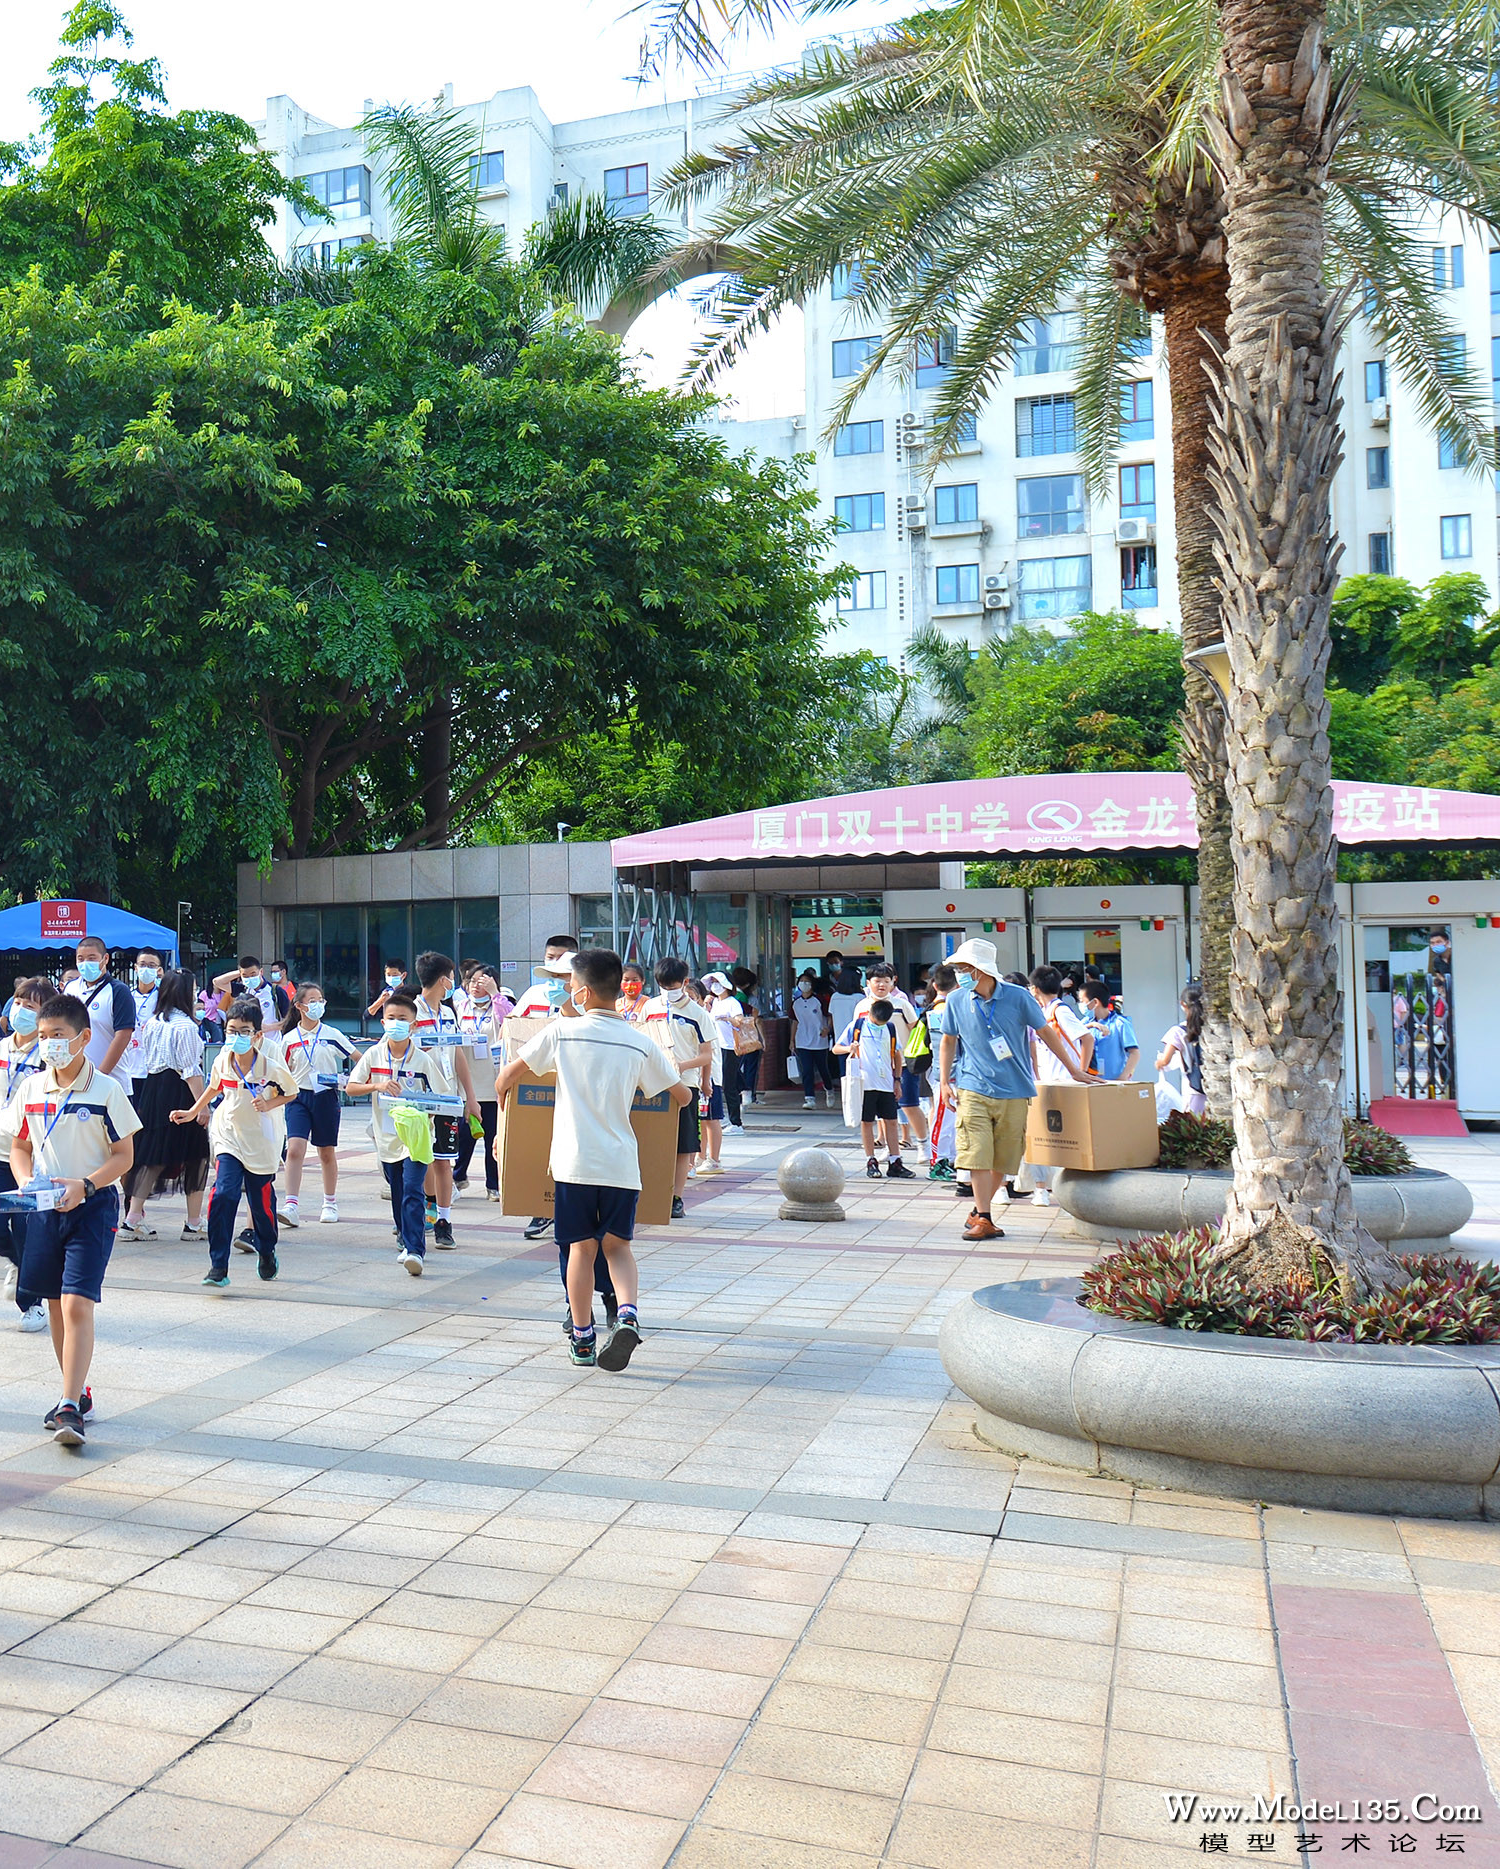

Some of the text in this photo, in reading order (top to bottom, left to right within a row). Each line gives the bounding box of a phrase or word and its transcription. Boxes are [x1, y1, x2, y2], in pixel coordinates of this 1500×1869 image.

[752, 801, 1011, 850] 厦门双十中学
[1027, 835, 1083, 844] KING LONG
